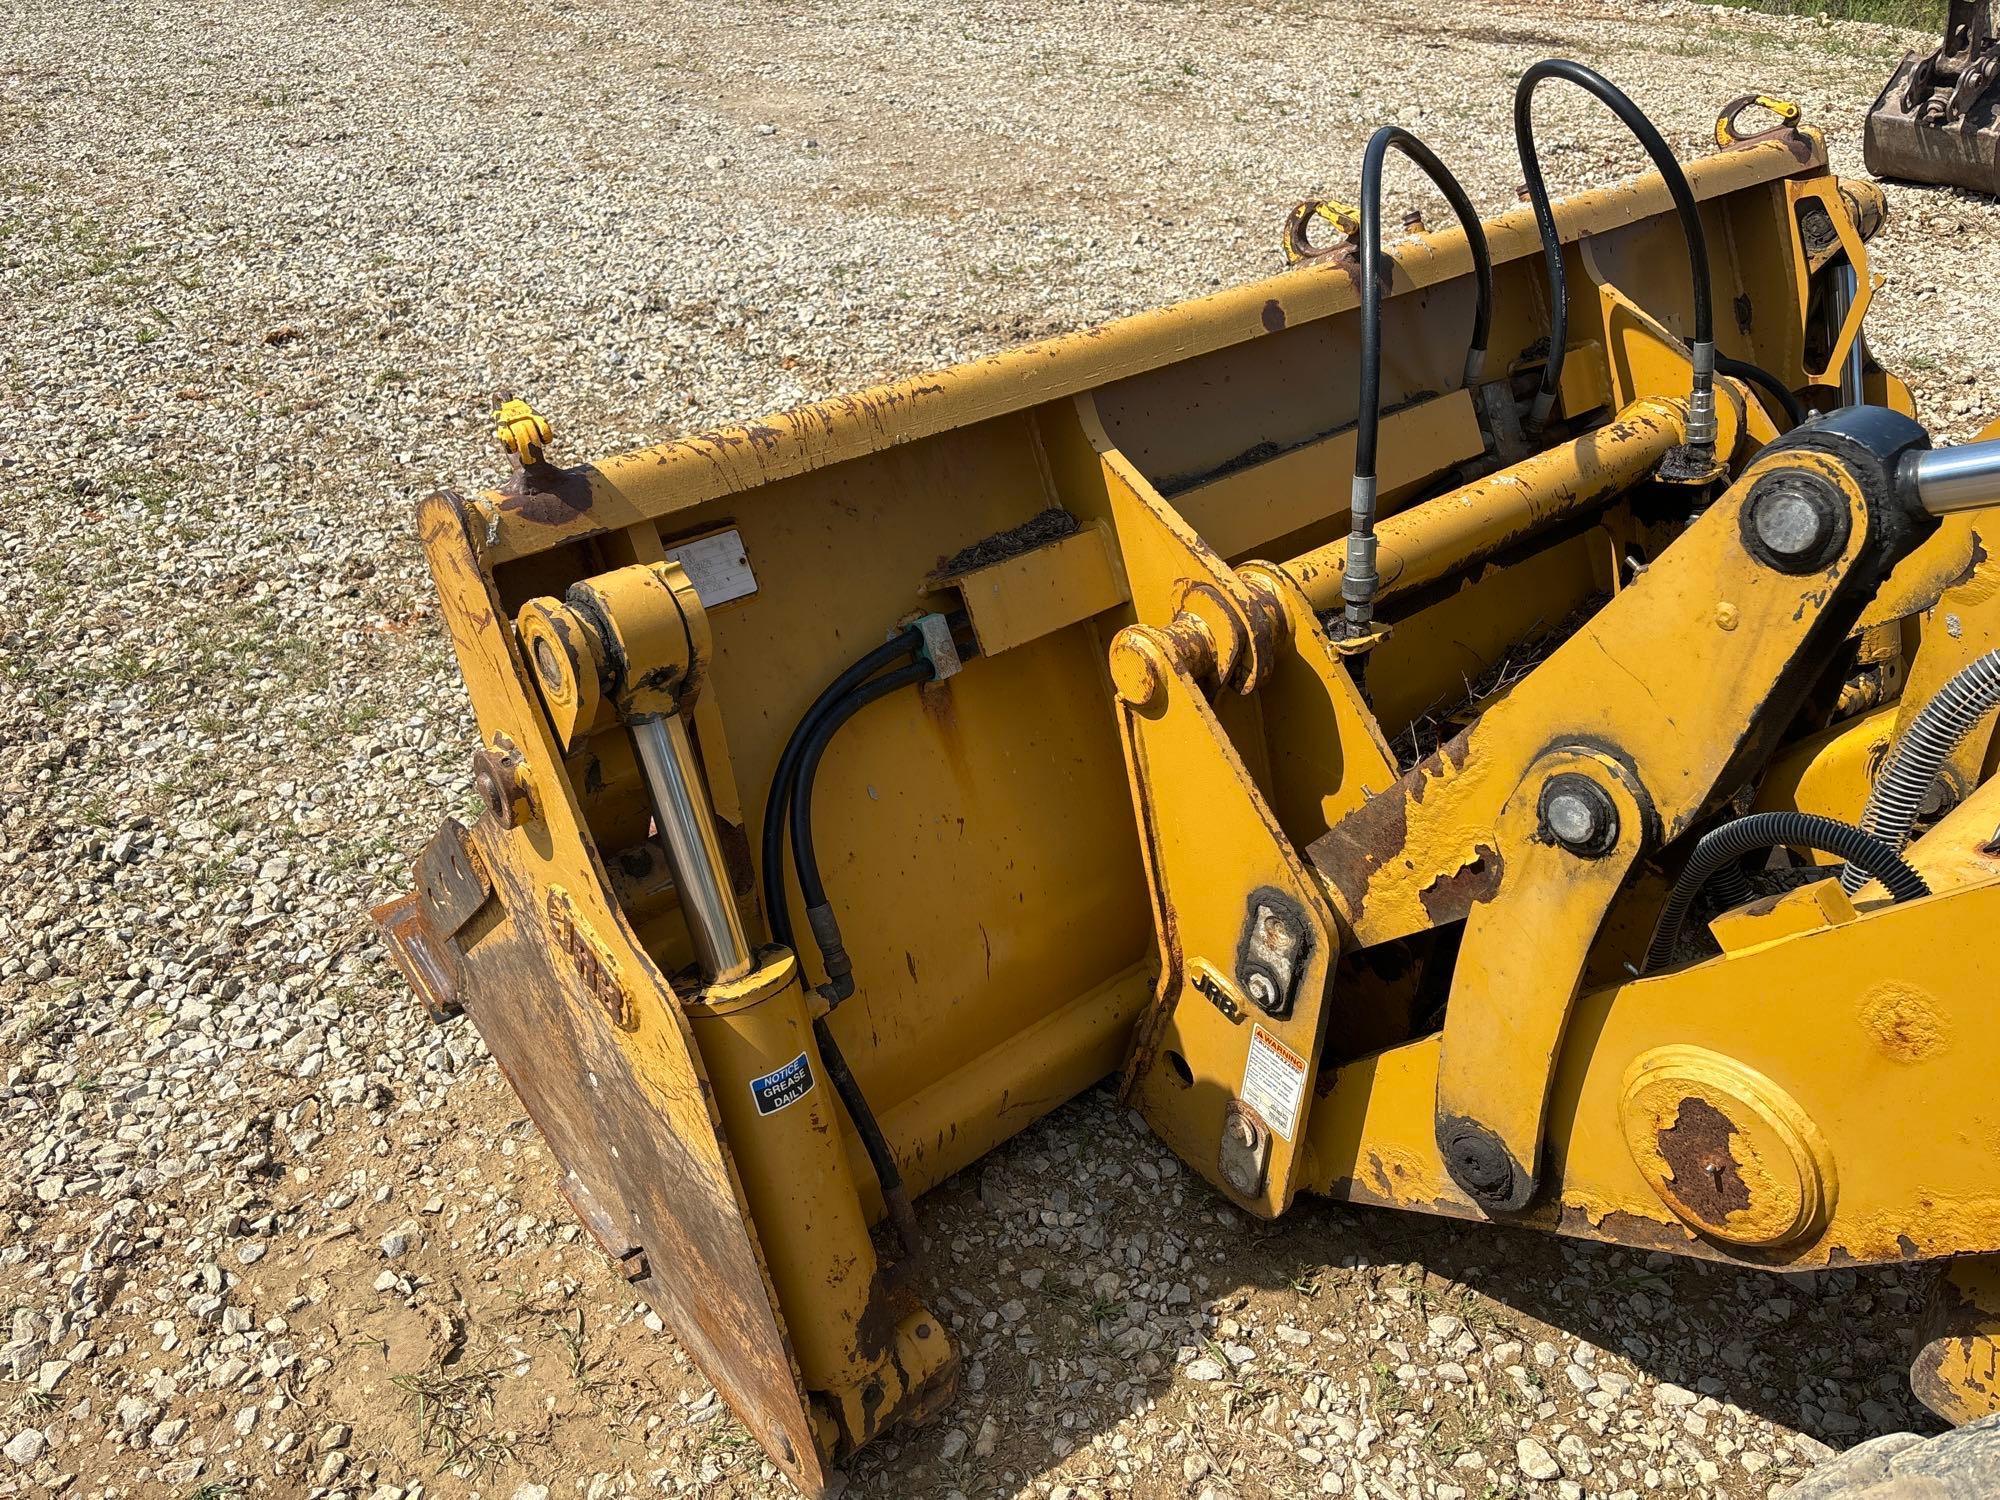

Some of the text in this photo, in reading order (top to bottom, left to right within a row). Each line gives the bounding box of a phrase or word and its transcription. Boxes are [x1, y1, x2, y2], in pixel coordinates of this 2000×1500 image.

[1191, 973, 1238, 1018] JRB
[1264, 1034, 1303, 1069] WARNING
[763, 1068, 806, 1097] GREASE
[764, 1061, 799, 1087] NOTICE
[774, 1084, 803, 1107] DAILY
